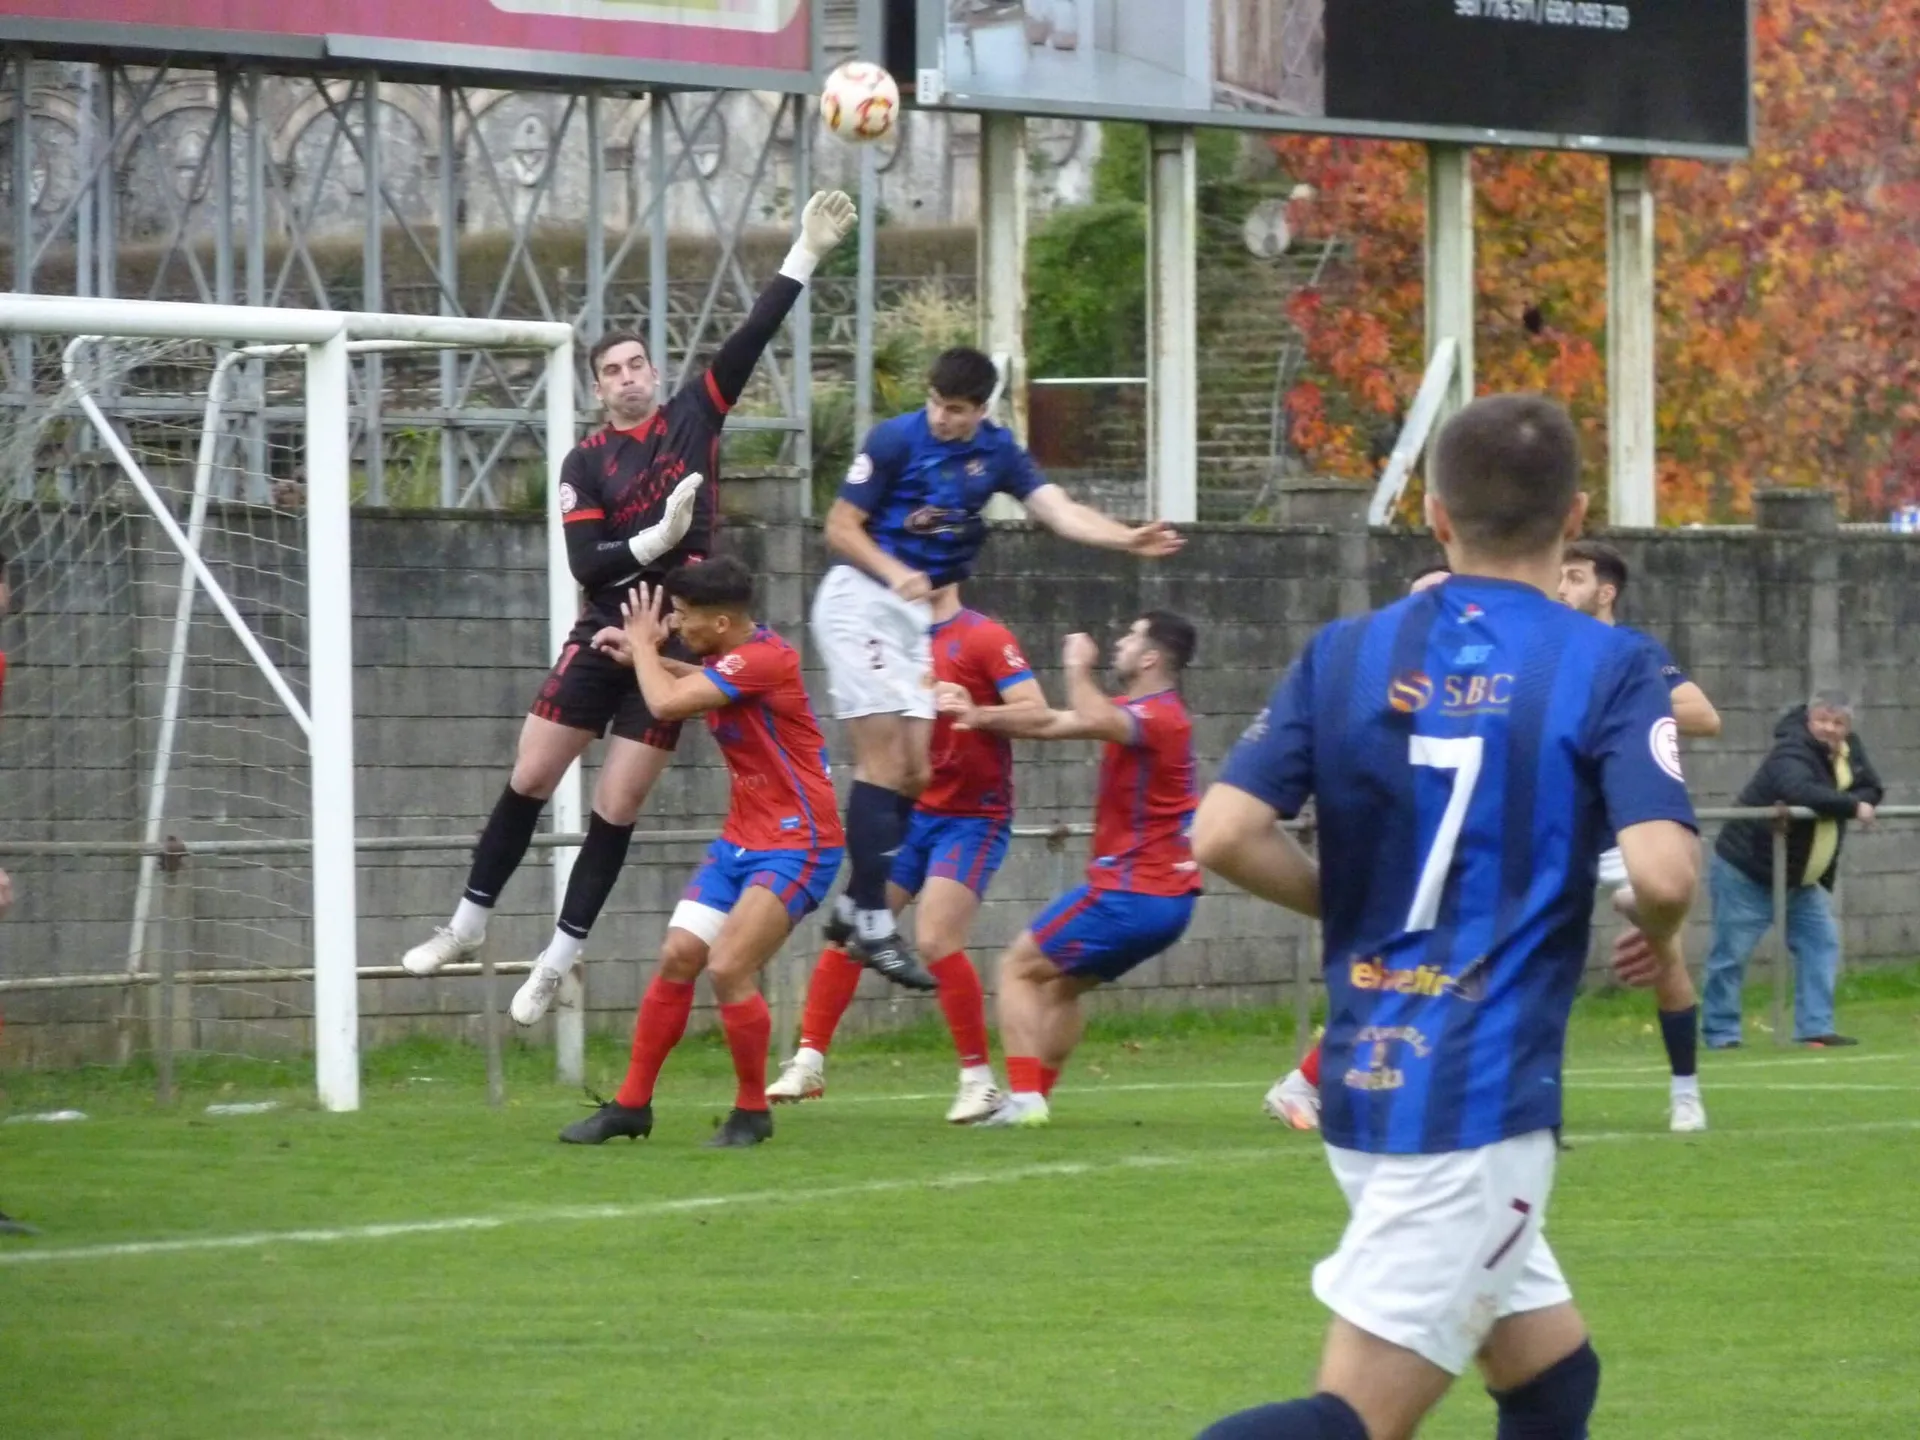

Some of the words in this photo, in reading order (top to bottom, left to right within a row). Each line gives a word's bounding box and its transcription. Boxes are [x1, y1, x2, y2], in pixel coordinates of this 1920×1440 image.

[1442, 672, 1515, 707] SBC
[1404, 735, 1484, 933] 7
[1483, 1197, 1532, 1270] 7
